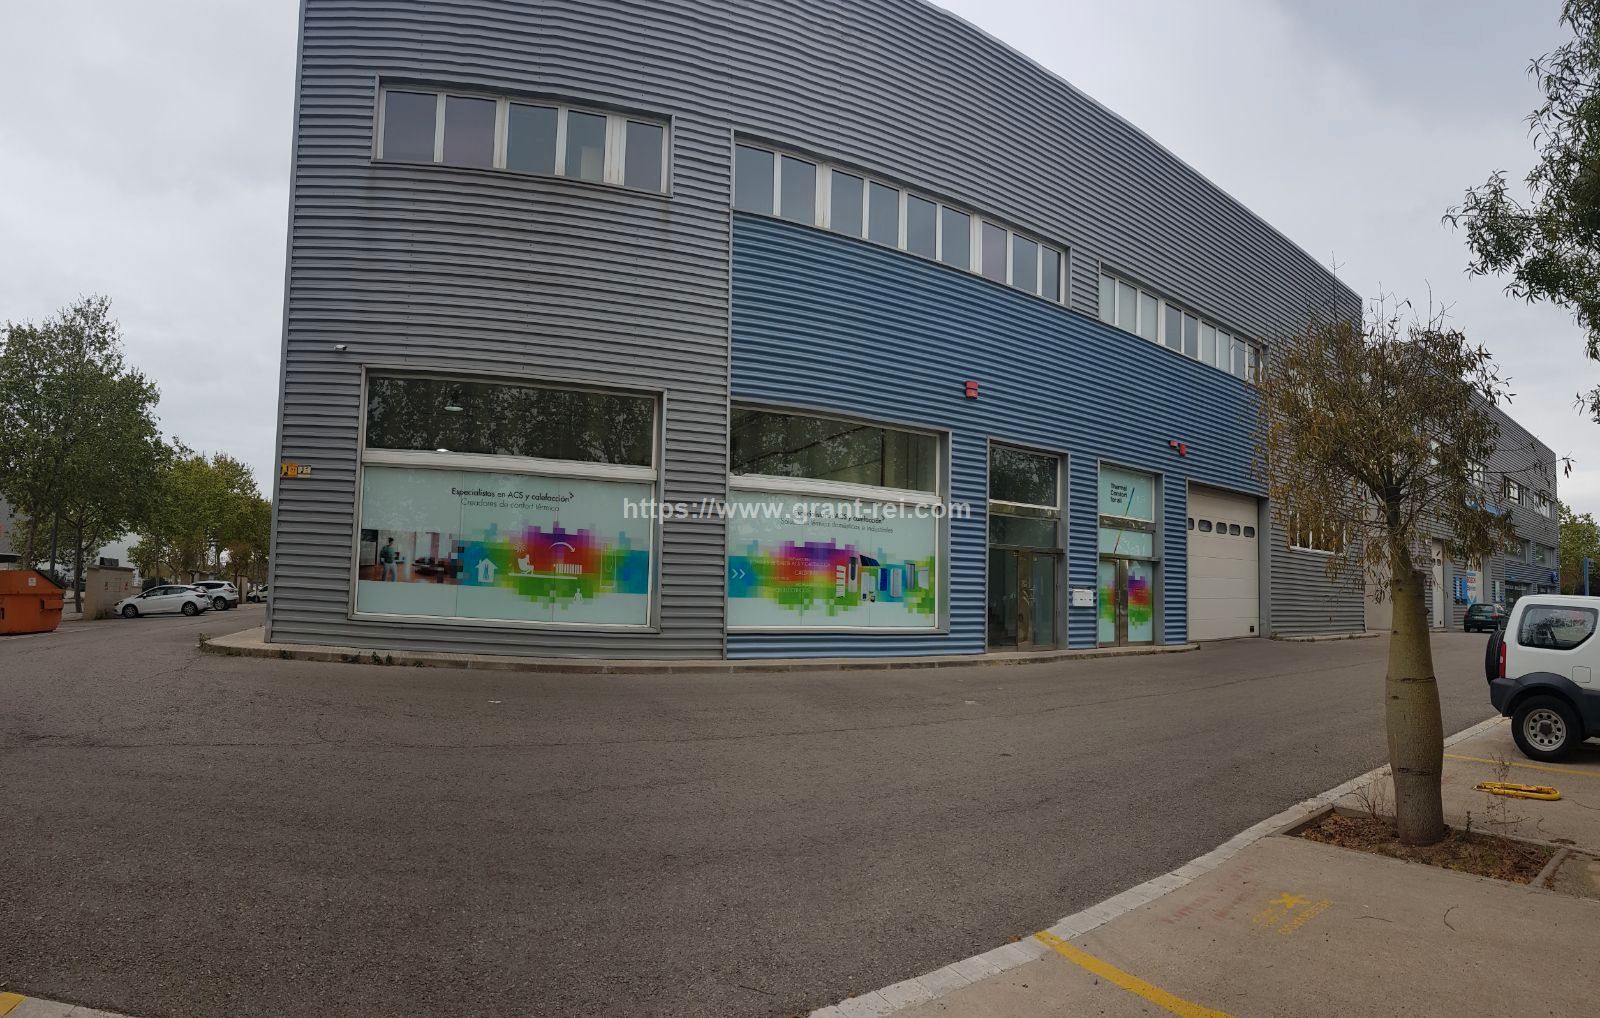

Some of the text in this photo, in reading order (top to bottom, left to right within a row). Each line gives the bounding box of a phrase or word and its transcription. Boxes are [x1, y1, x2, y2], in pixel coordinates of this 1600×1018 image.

[451, 487, 495, 498] Especialistas
[507, 491, 524, 499] ACS
[531, 492, 569, 503] calefacción
[460, 497, 497, 507] Creadores
[499, 499, 508, 508] de
[511, 501, 534, 510] confort
